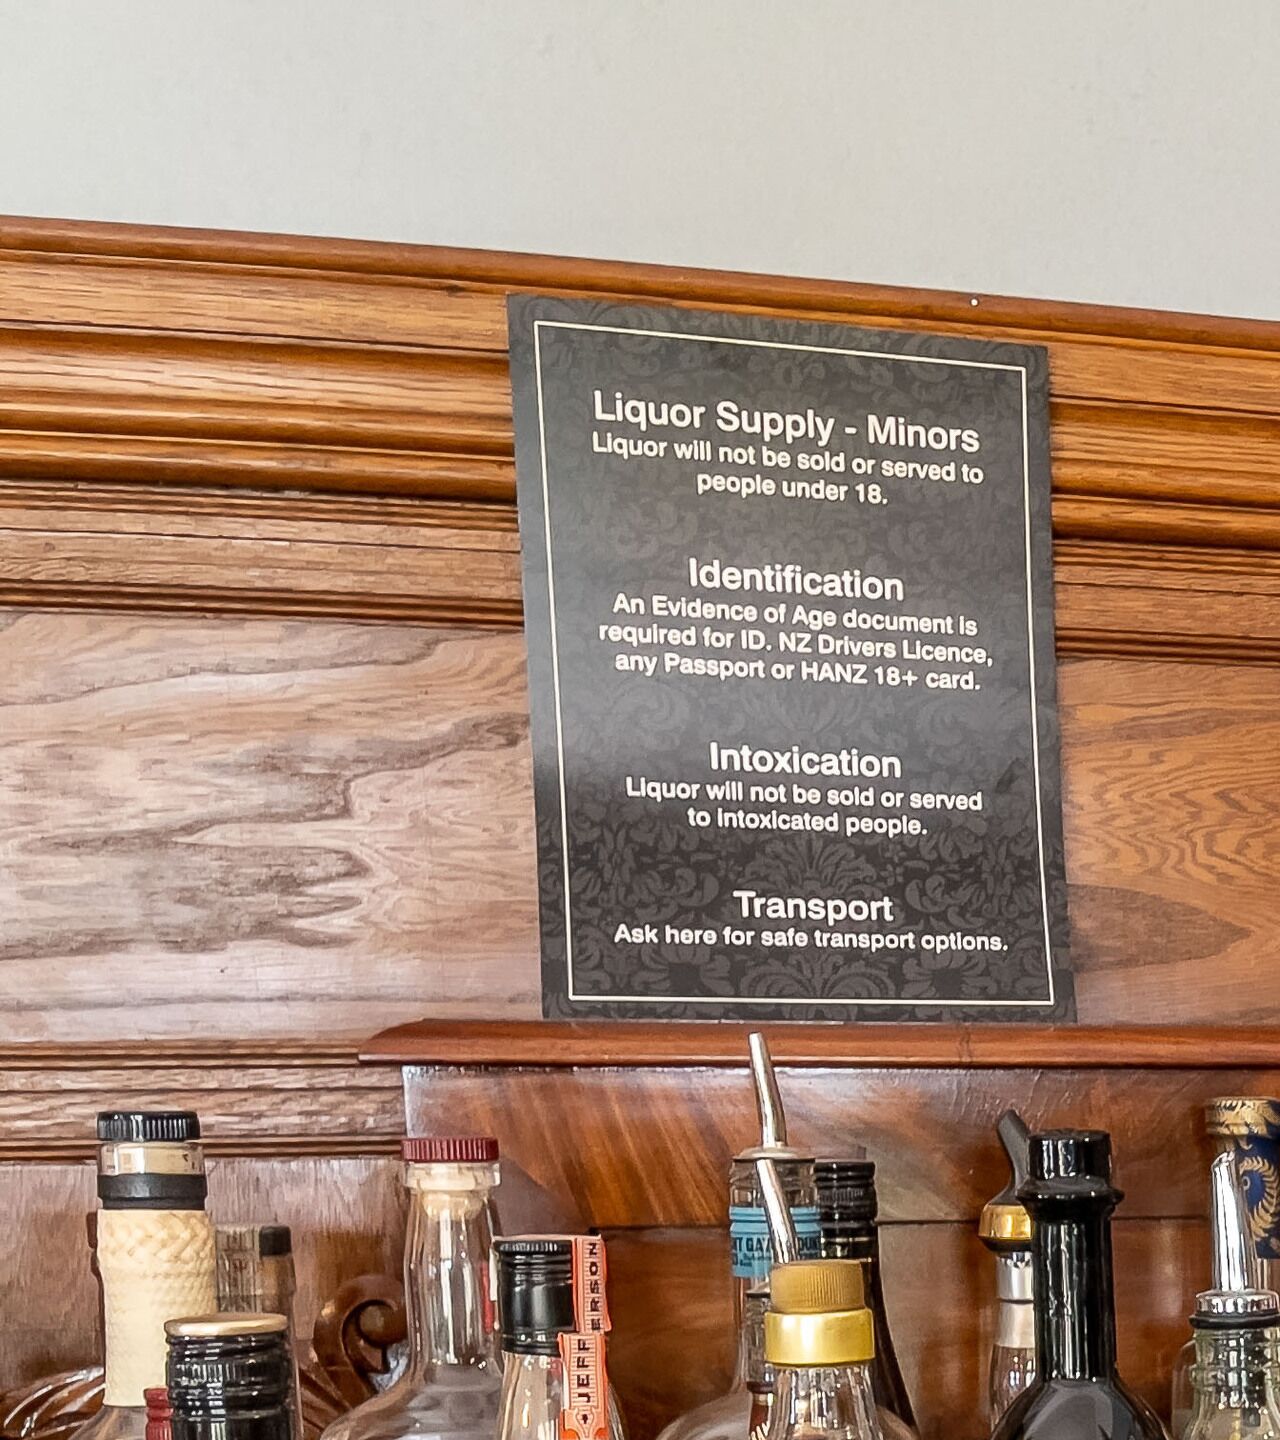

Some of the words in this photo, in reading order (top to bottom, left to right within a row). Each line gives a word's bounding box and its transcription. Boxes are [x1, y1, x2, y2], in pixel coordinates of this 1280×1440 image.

[594, 391, 705, 431] Liquor
[717, 402, 834, 447] Supply
[867, 414, 980, 453] Minors
[593, 432, 667, 460] Liquor
[674, 441, 711, 462] will
[719, 446, 755, 465] not
[761, 447, 790, 468] be
[796, 450, 845, 473] sold
[852, 457, 875, 475] or
[881, 457, 955, 482] served
[962, 463, 984, 484] to
[697, 472, 776, 496] people
[782, 475, 848, 500] under
[855, 484, 887, 505] 18.
[689, 557, 904, 601] Identification
[613, 593, 644, 615] An
[652, 595, 757, 623] Evidence
[764, 604, 788, 624] of
[792, 605, 837, 632] Age
[843, 609, 953, 636] document
[960, 615, 977, 636] is
[599, 623, 696, 650] required
[703, 629, 735, 650] for
[741, 630, 772, 652] ID.
[779, 632, 812, 653] NZ
[819, 635, 896, 660] Drivers
[903, 641, 993, 668] Licence,
[615, 653, 657, 677] any
[664, 656, 766, 682] Passport
[771, 662, 794, 680] or
[801, 662, 867, 685] HANZ
[874, 667, 918, 687] 18+
[925, 669, 981, 691] card.
[710, 742, 902, 778] Intoxication
[626, 776, 700, 802] Liquor
[706, 782, 743, 802] will
[749, 784, 786, 804] not
[792, 785, 821, 805] be
[826, 786, 874, 808] sold
[881, 792, 904, 808] or
[910, 789, 982, 812] served
[687, 810, 711, 828] to
[717, 809, 839, 833] intoxicated
[845, 814, 928, 838] people.
[734, 890, 894, 922] Transport
[614, 924, 658, 944] Ask
[665, 926, 717, 945] here
[723, 928, 754, 947] for
[761, 928, 808, 948] safe
[814, 930, 916, 952] transport
[921, 933, 1009, 952] options.
